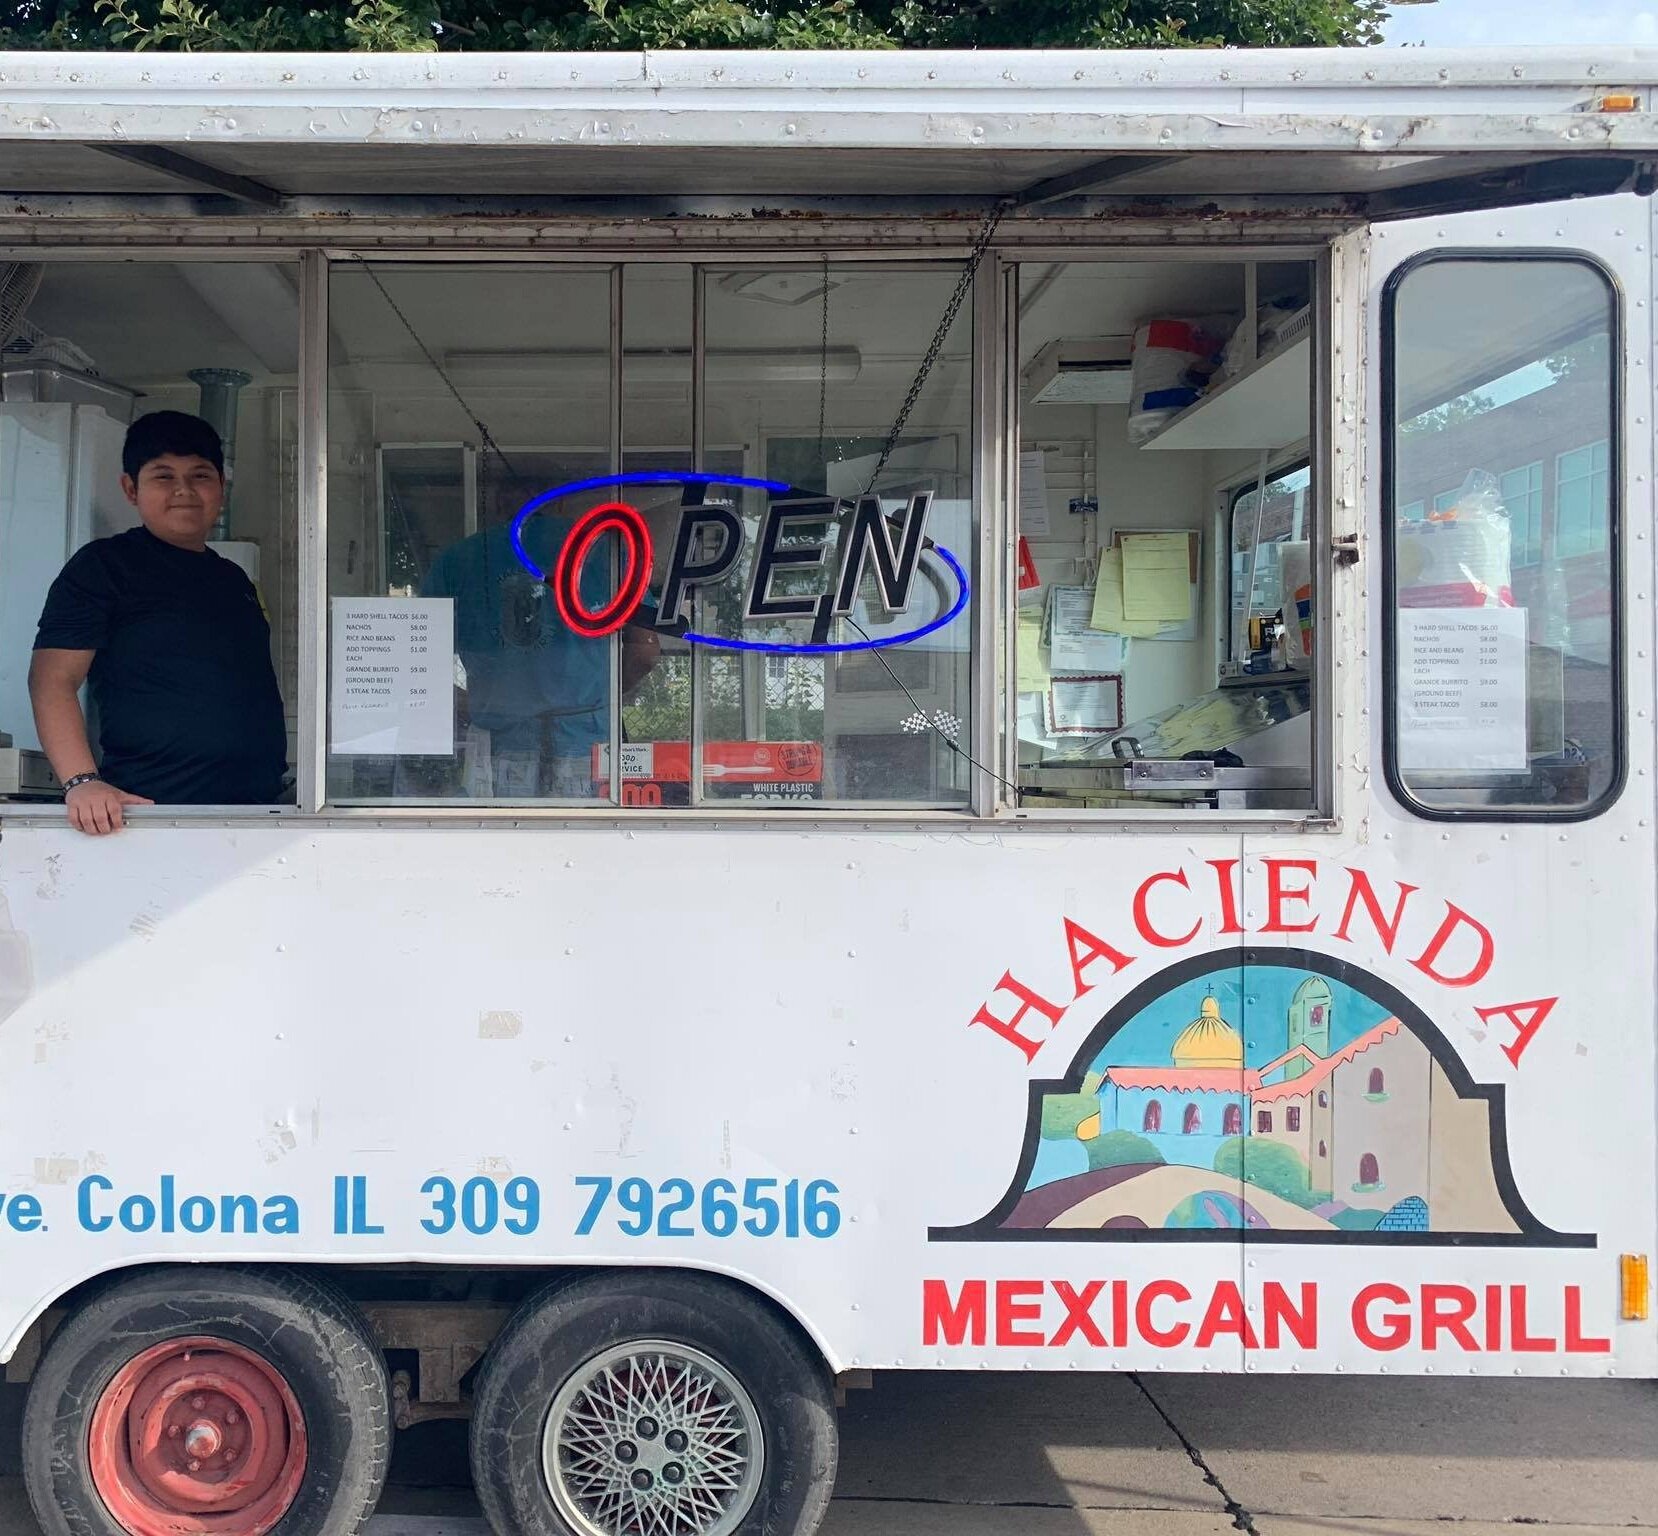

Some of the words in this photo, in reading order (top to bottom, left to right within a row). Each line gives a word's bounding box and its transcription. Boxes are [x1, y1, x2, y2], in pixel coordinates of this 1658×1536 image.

[554, 490, 935, 638] OPEN
[753, 783, 778, 793] WHITE
[780, 783, 814, 793] PLASTIC
[969, 859, 1559, 1067] HACIENDA
[77, 1173, 300, 1235] Colona
[333, 1175, 385, 1236] IL
[420, 1175, 541, 1237] 309
[575, 1175, 842, 1240] 7926516
[923, 1279, 1318, 1349] MEXICAN
[1351, 1283, 1611, 1353] GRILL
